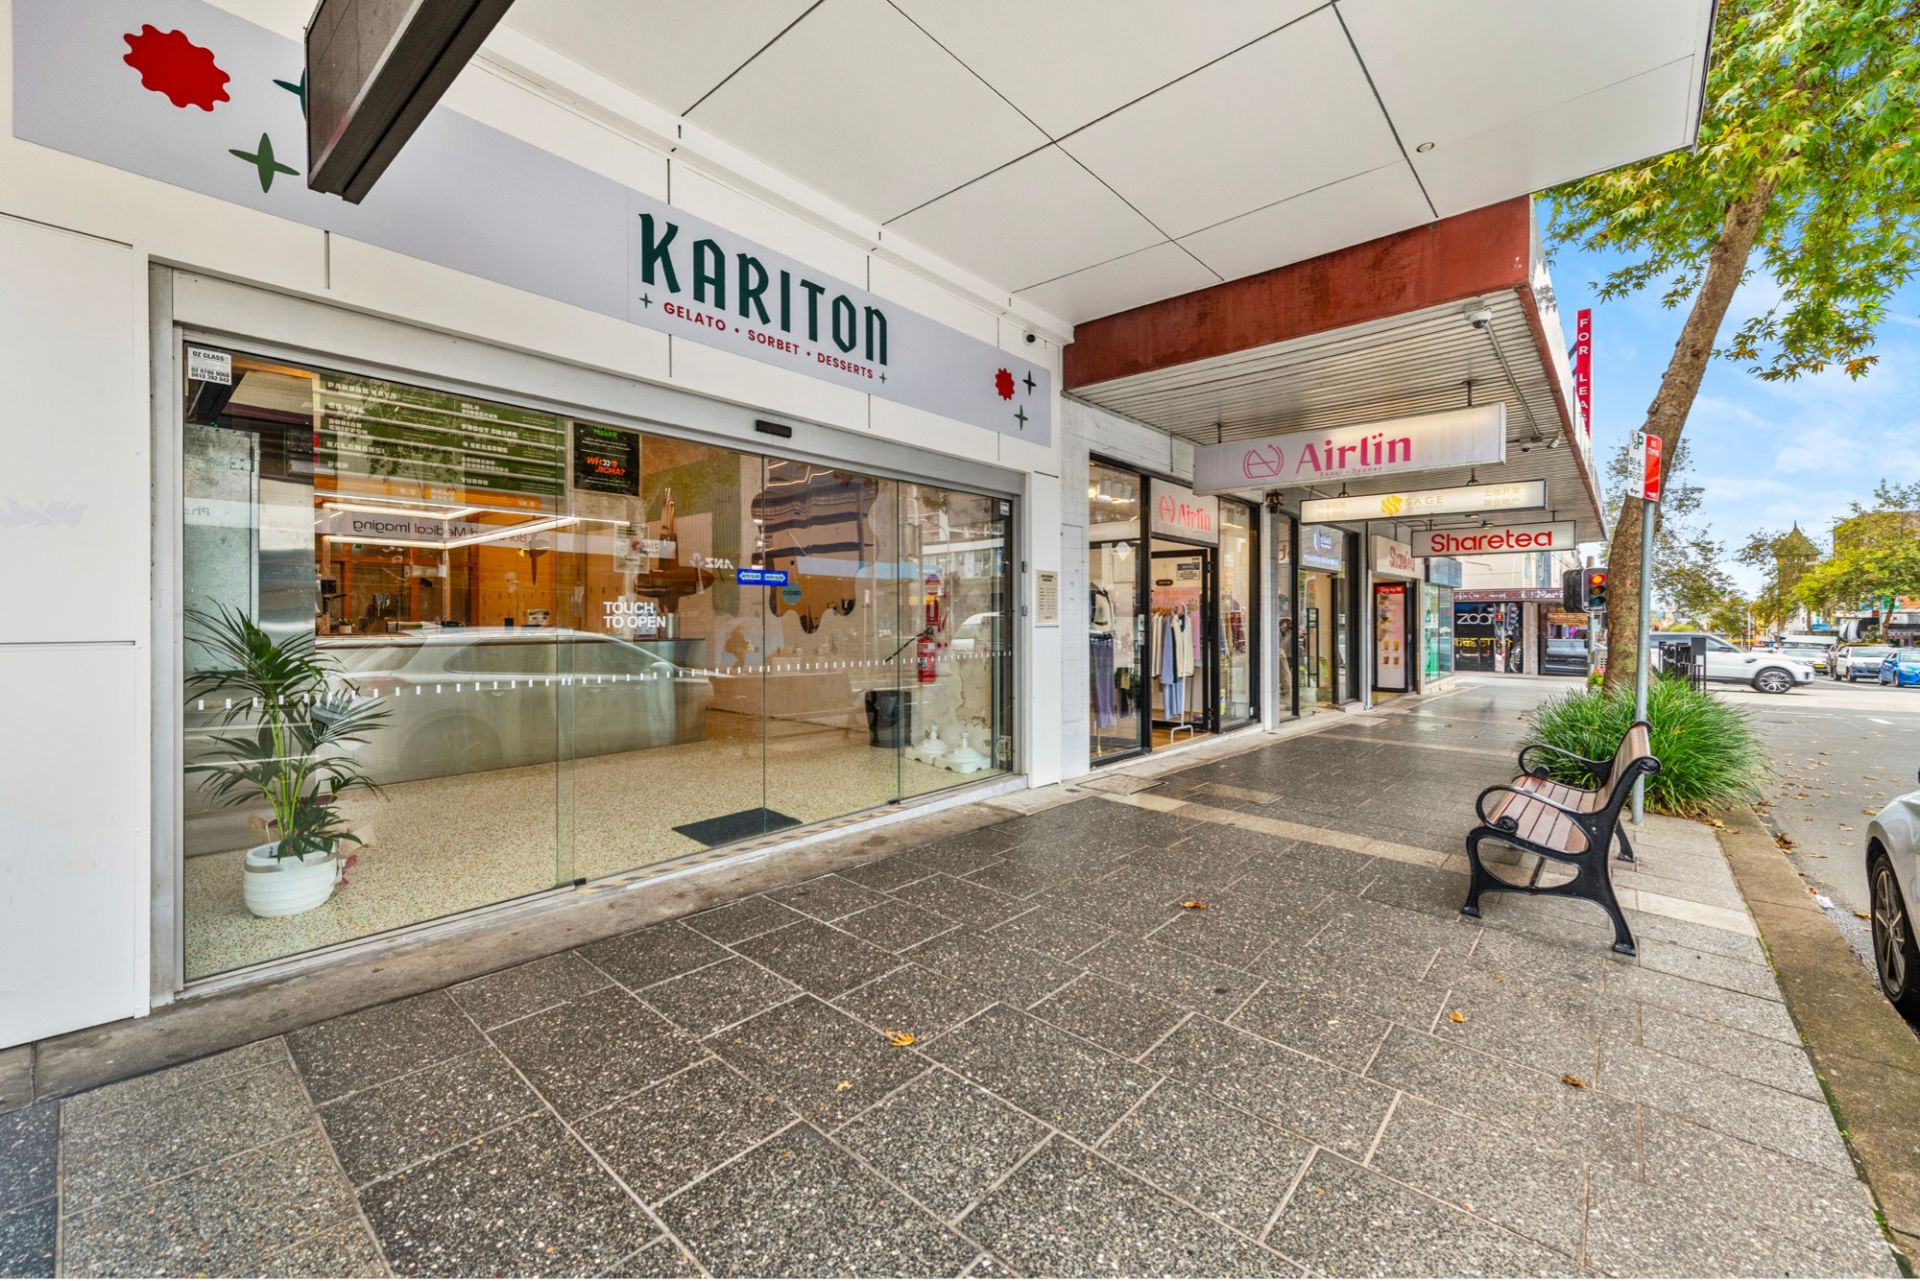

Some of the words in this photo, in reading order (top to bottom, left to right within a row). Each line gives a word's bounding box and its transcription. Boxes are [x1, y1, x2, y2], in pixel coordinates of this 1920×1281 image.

[638, 213, 888, 366] KARITON
[663, 302, 726, 331] GELATO
[747, 329, 800, 356] SORBET
[817, 352, 873, 379] DESSERTS
[1578, 318, 1590, 355] FOR
[203, 352, 225, 361] GLASS
[1406, 495, 1444, 508] SAGE
[1431, 529, 1553, 553] Sharetea
[603, 601, 655, 615] TOUCH
[603, 615, 625, 628] TO
[627, 615, 667, 628] OPEN
[1456, 612, 1494, 626] ZOO
